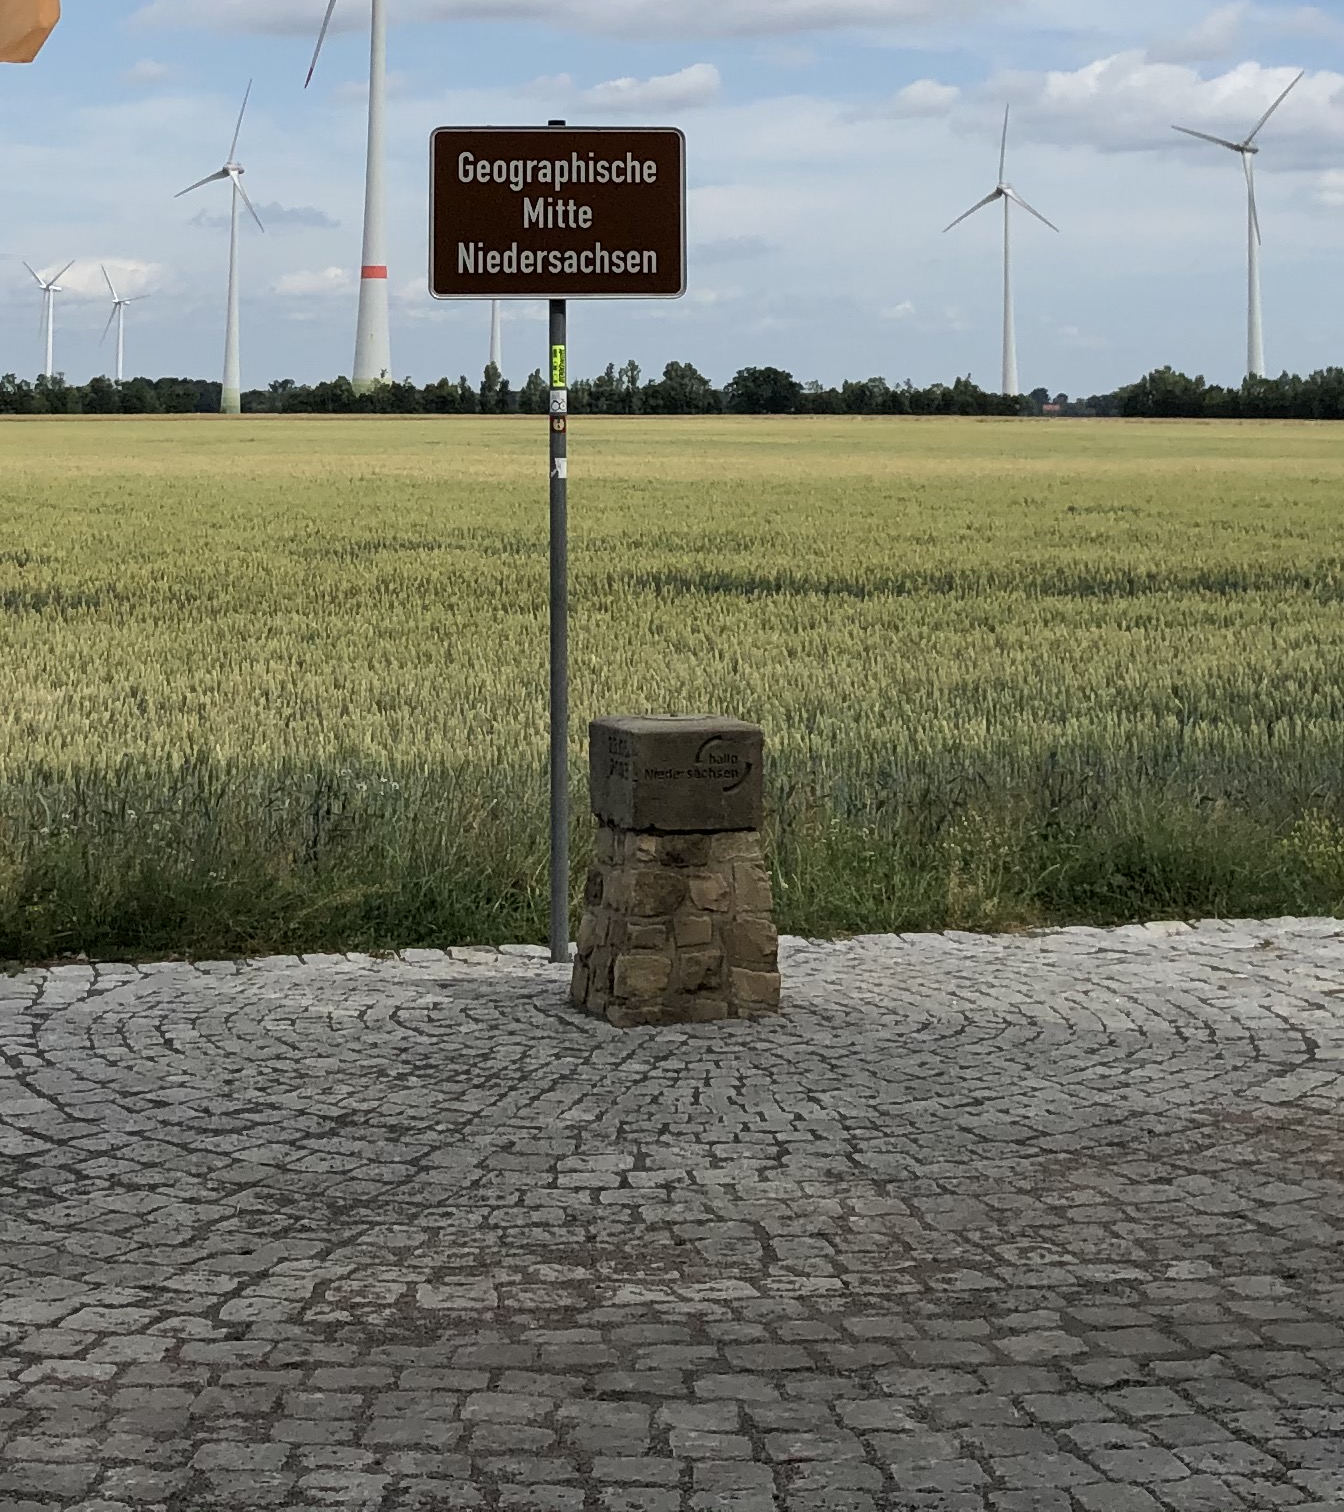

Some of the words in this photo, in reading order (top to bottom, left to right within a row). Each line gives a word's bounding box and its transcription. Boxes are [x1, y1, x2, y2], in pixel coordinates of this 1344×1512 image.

[458, 151, 657, 191] Geographische
[523, 196, 593, 229] Mitte
[458, 241, 657, 274] Niedersachsen
[644, 767, 739, 780] Niedersachsen
